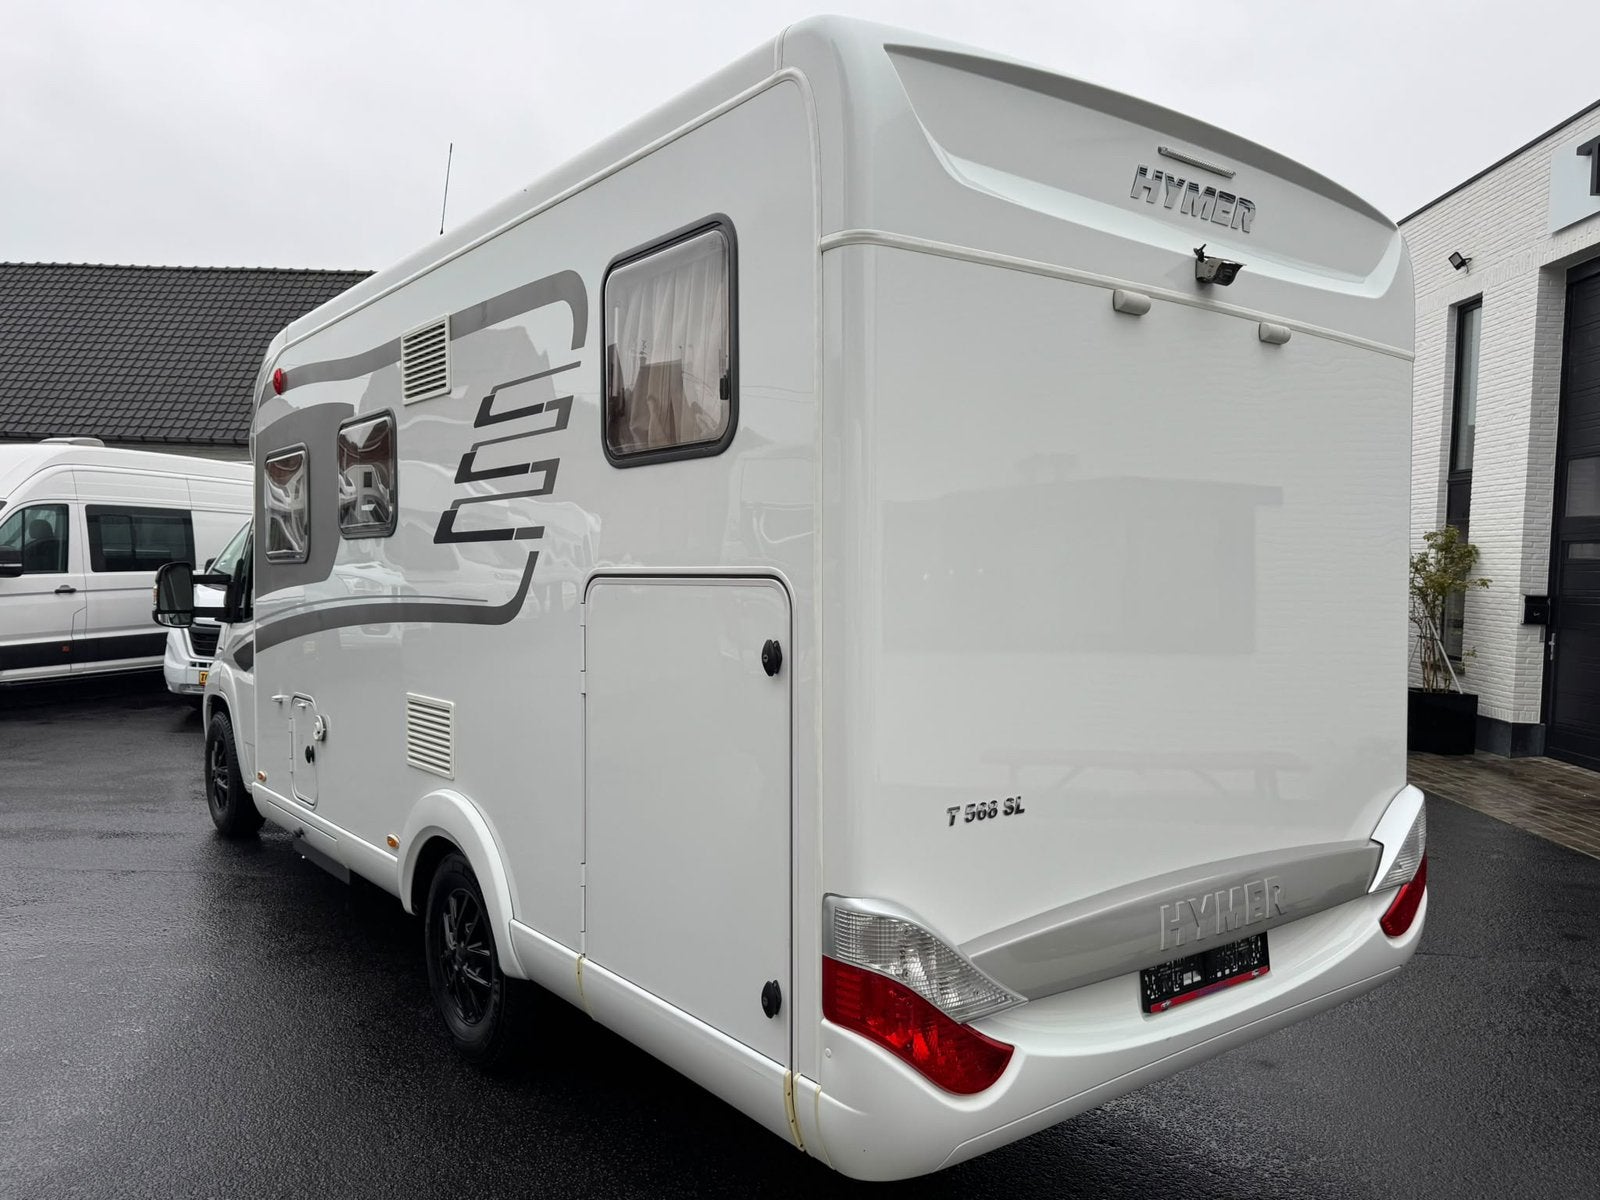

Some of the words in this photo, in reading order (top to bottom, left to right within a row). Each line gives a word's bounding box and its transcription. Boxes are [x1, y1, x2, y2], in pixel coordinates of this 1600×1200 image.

[1130, 163, 1256, 234] HYMER
[946, 805, 961, 827] T
[963, 800, 998, 823] 568
[1002, 796, 1025, 816] SL
[1160, 876, 1288, 951] HYMER
